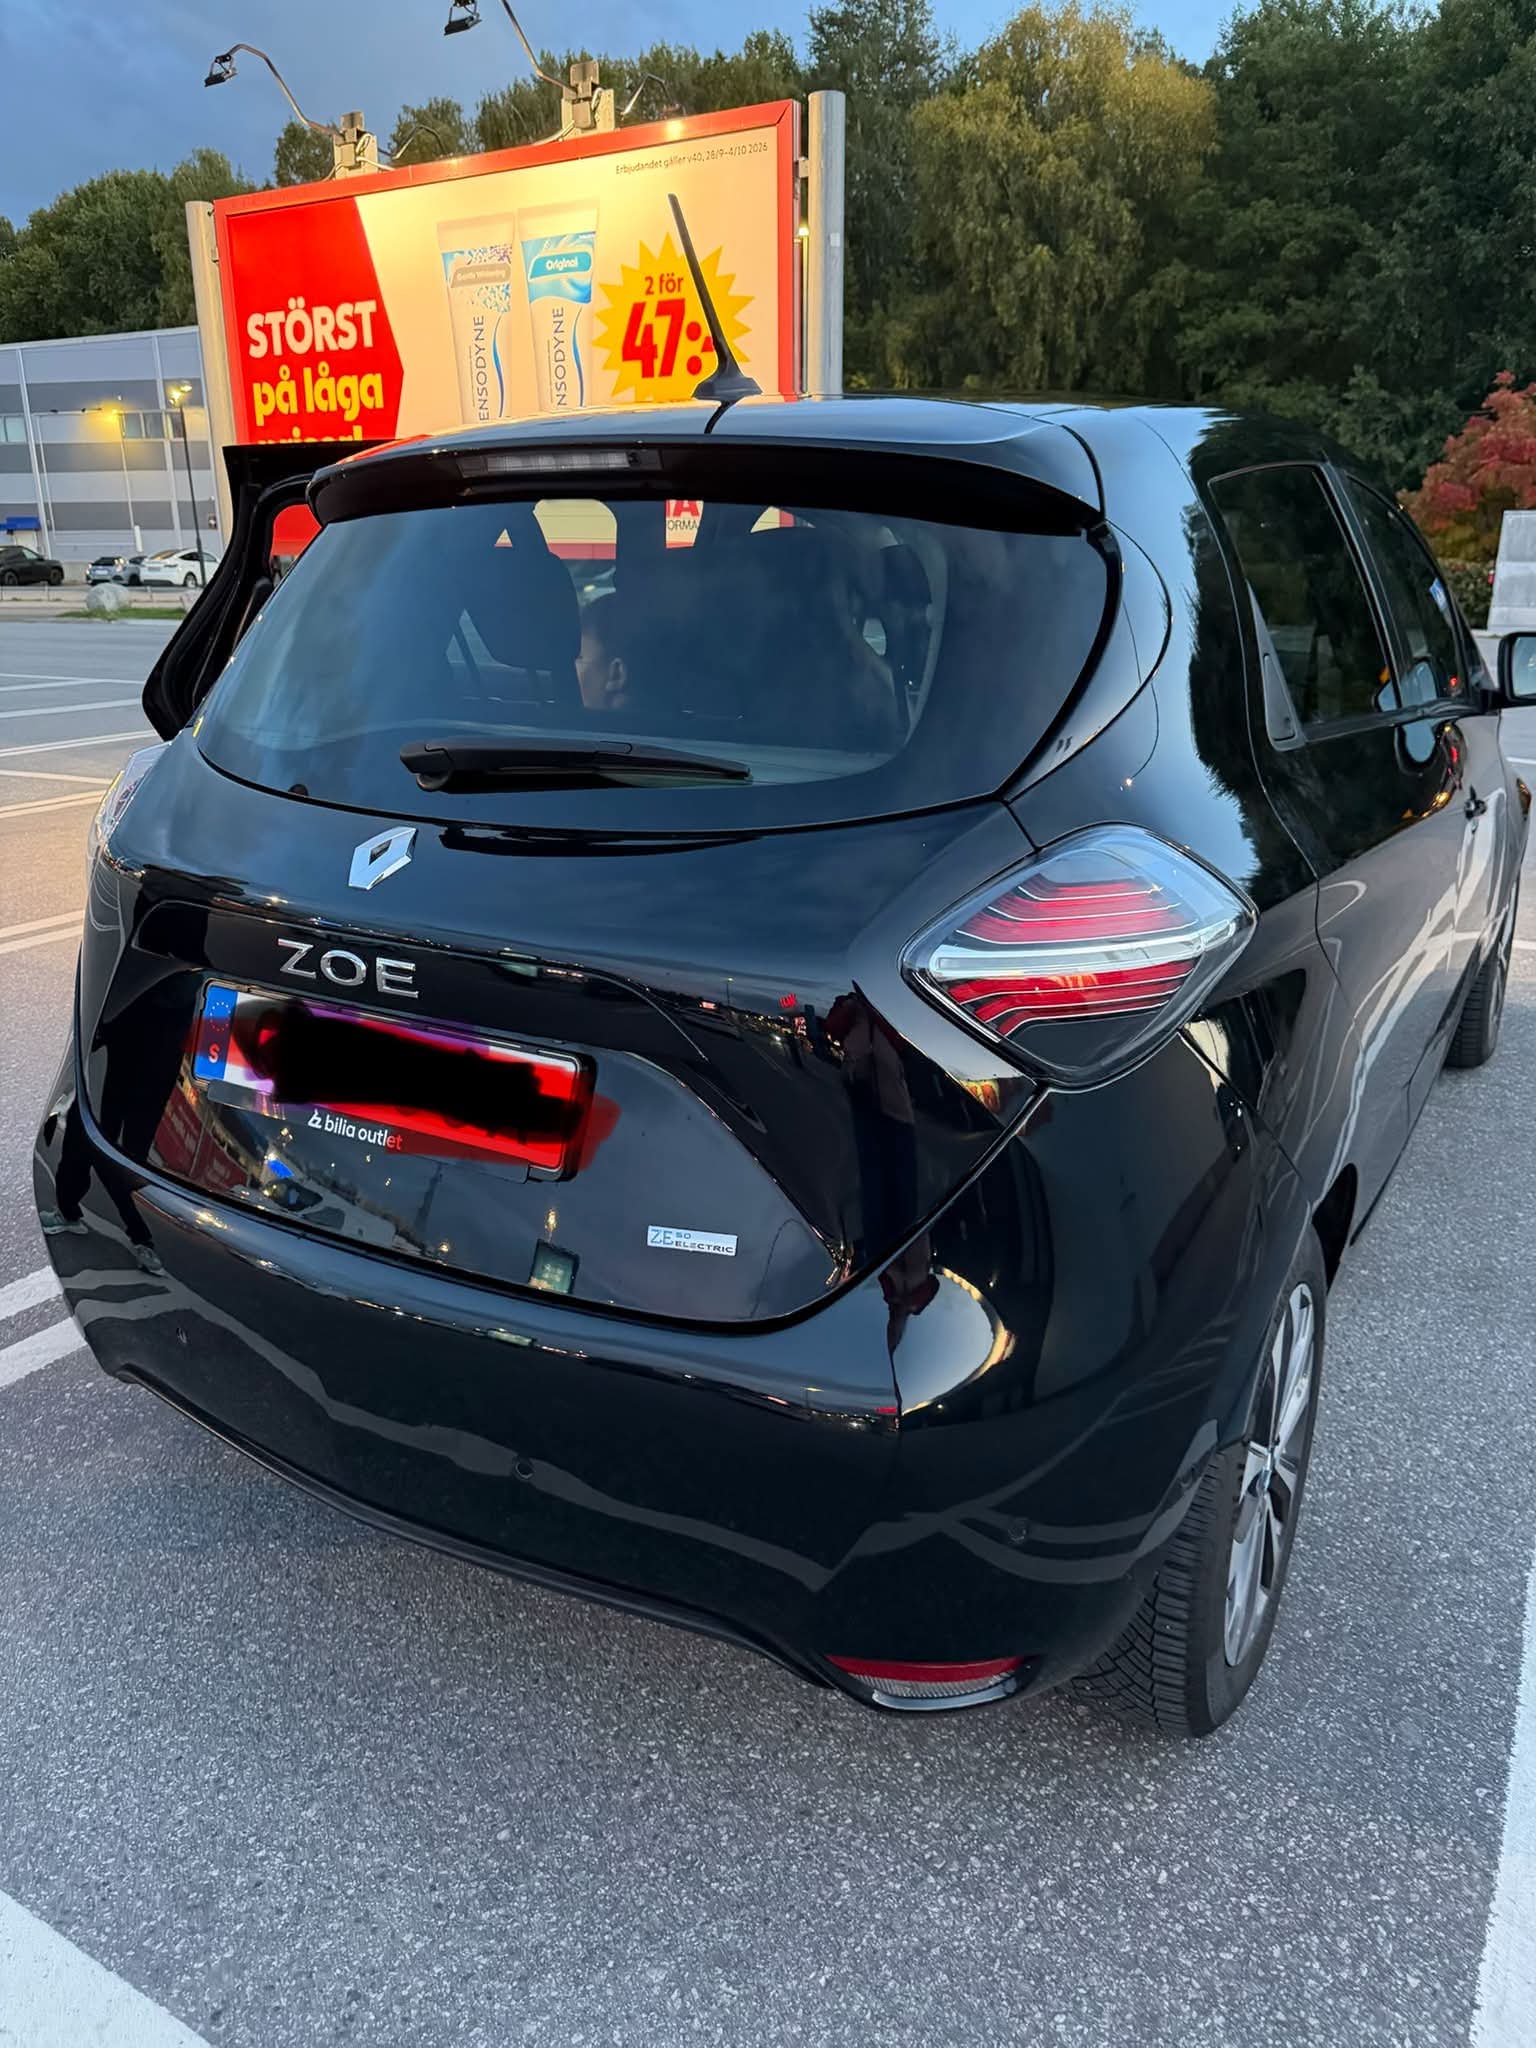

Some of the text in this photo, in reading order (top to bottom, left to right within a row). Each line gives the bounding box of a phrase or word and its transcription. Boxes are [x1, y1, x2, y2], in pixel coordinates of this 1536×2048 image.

[615, 160, 662, 175] Erbjudandet
[546, 257, 579, 271] Original
[644, 272, 684, 296] 2 för
[247, 296, 377, 359] STÖRST
[473, 315, 490, 421] ENSODYNE
[552, 307, 568, 406] NSODYNE
[252, 361, 385, 427] på låga
[667, 519, 698, 531] ORMA
[277, 938, 419, 999] ZOE
[208, 1043, 220, 1064] S
[324, 1117, 403, 1150] bilia outlet
[675, 1240, 734, 1253] ELECTRIC
